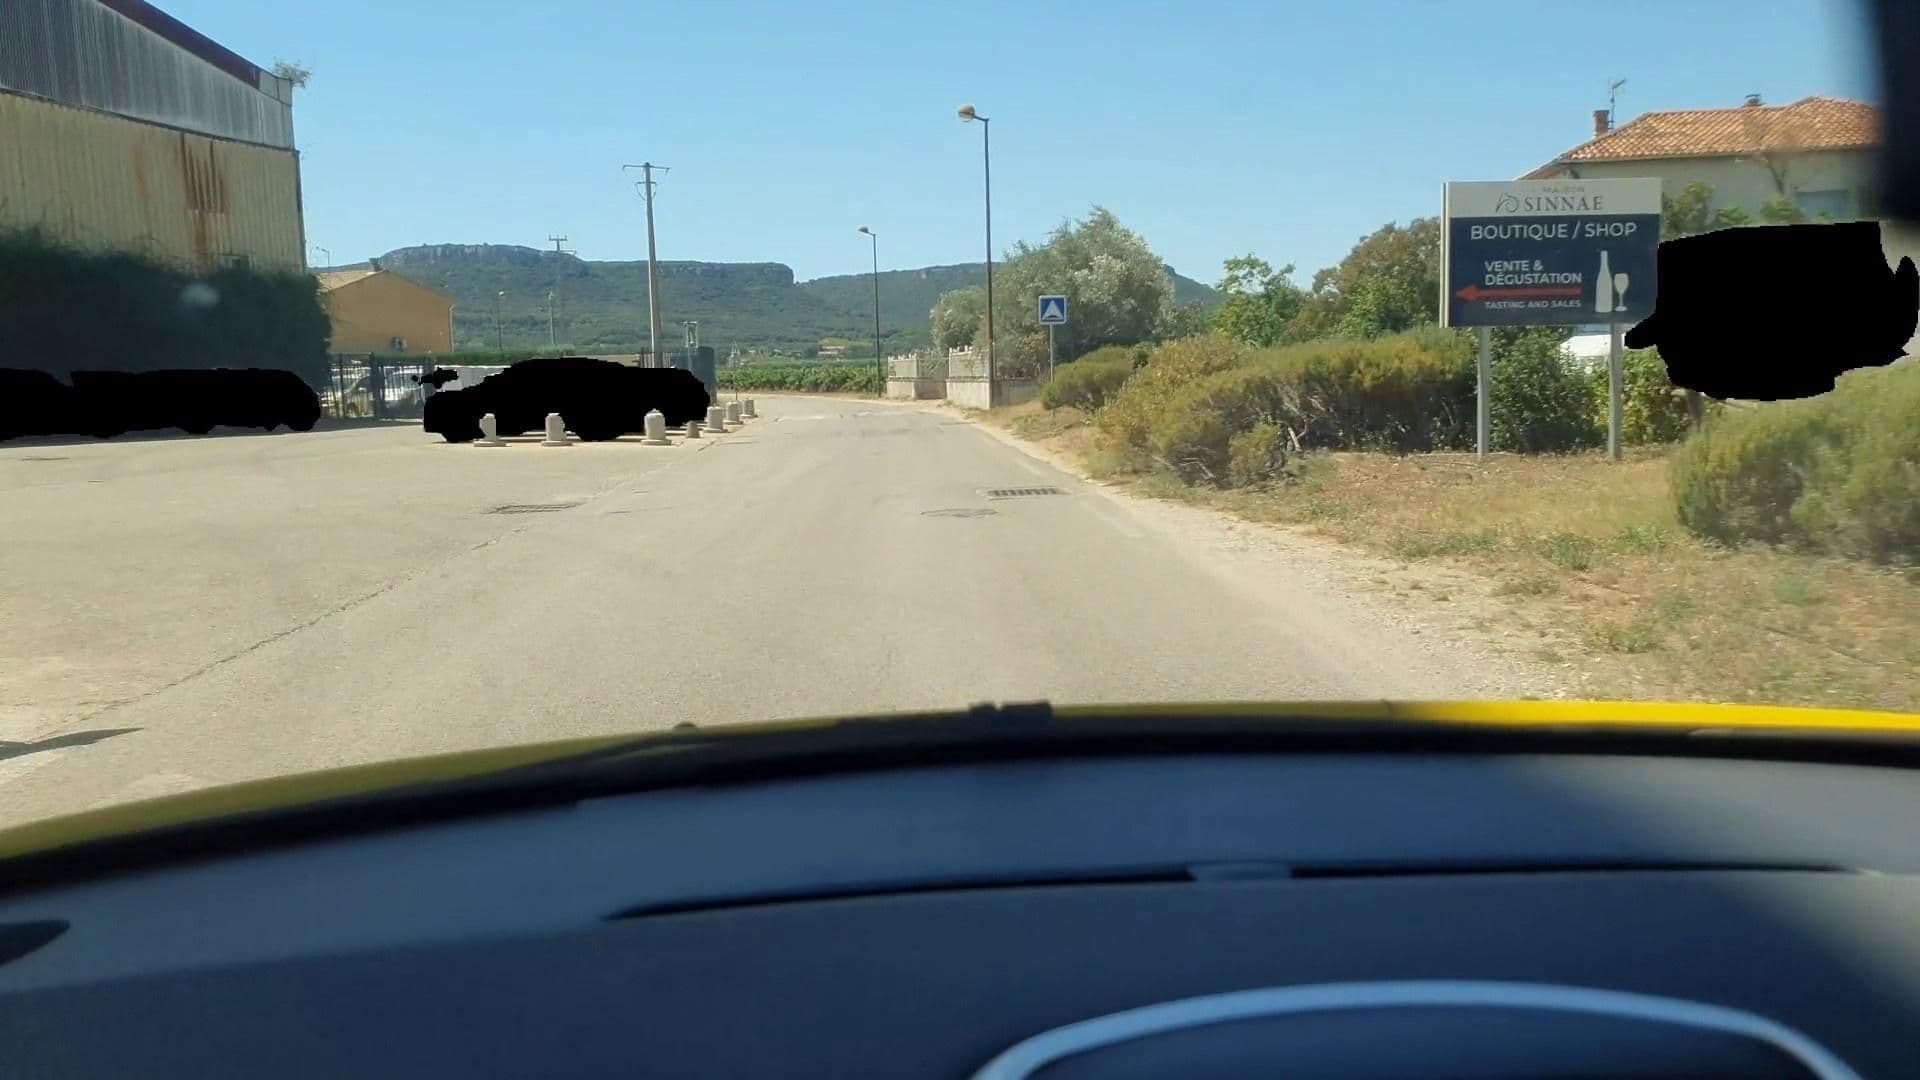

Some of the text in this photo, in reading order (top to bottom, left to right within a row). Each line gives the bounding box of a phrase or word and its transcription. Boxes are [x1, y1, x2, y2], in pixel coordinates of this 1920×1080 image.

[1524, 195, 1604, 212] SINNAE
[1470, 220, 1637, 241] BOUTIQUE / SHOP
[1484, 259, 1544, 271] VENTE &
[1484, 271, 1582, 286] DÉGUSTATION
[1485, 299, 1582, 309] TASTING AND SALES
